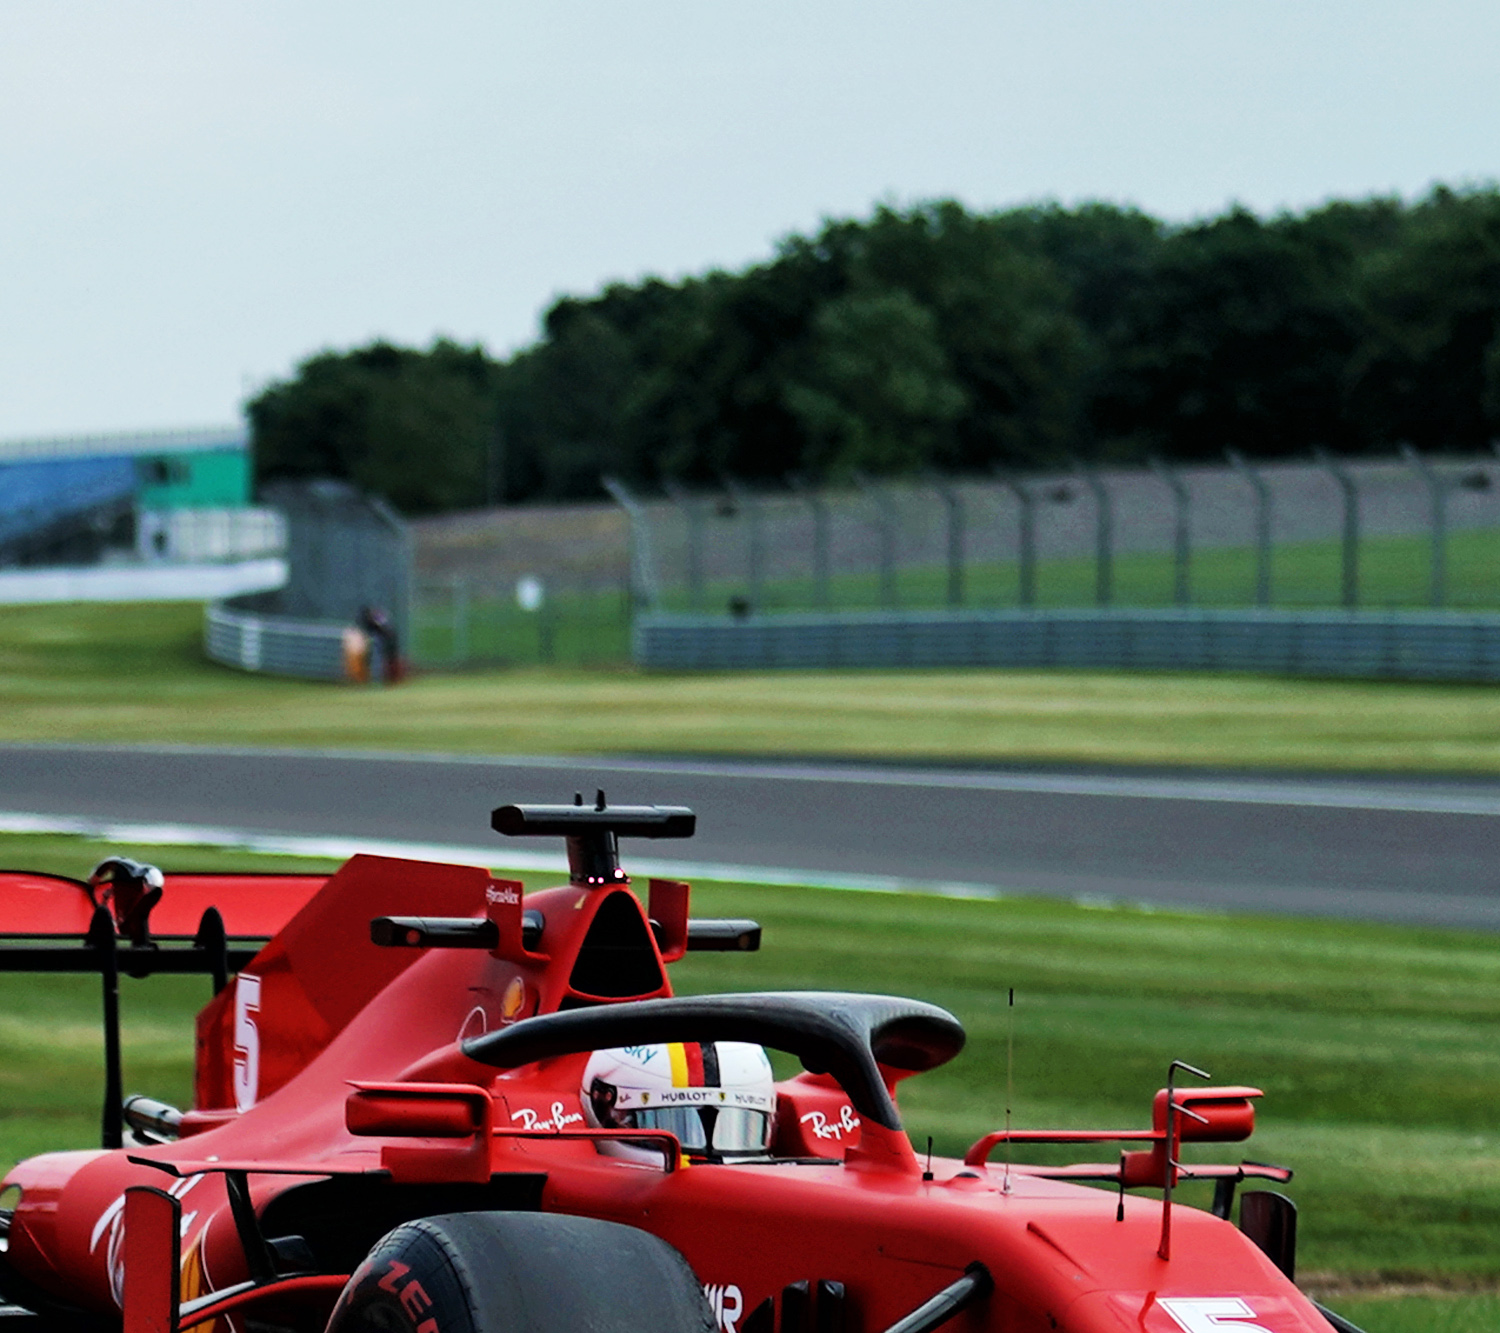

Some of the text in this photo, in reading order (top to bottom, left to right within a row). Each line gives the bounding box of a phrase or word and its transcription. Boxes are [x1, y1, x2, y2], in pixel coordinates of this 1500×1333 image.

[233, 972, 261, 1114] 5
[661, 1092, 707, 1102] HUBLOT
[801, 1105, 861, 1139] Ray-Ba
